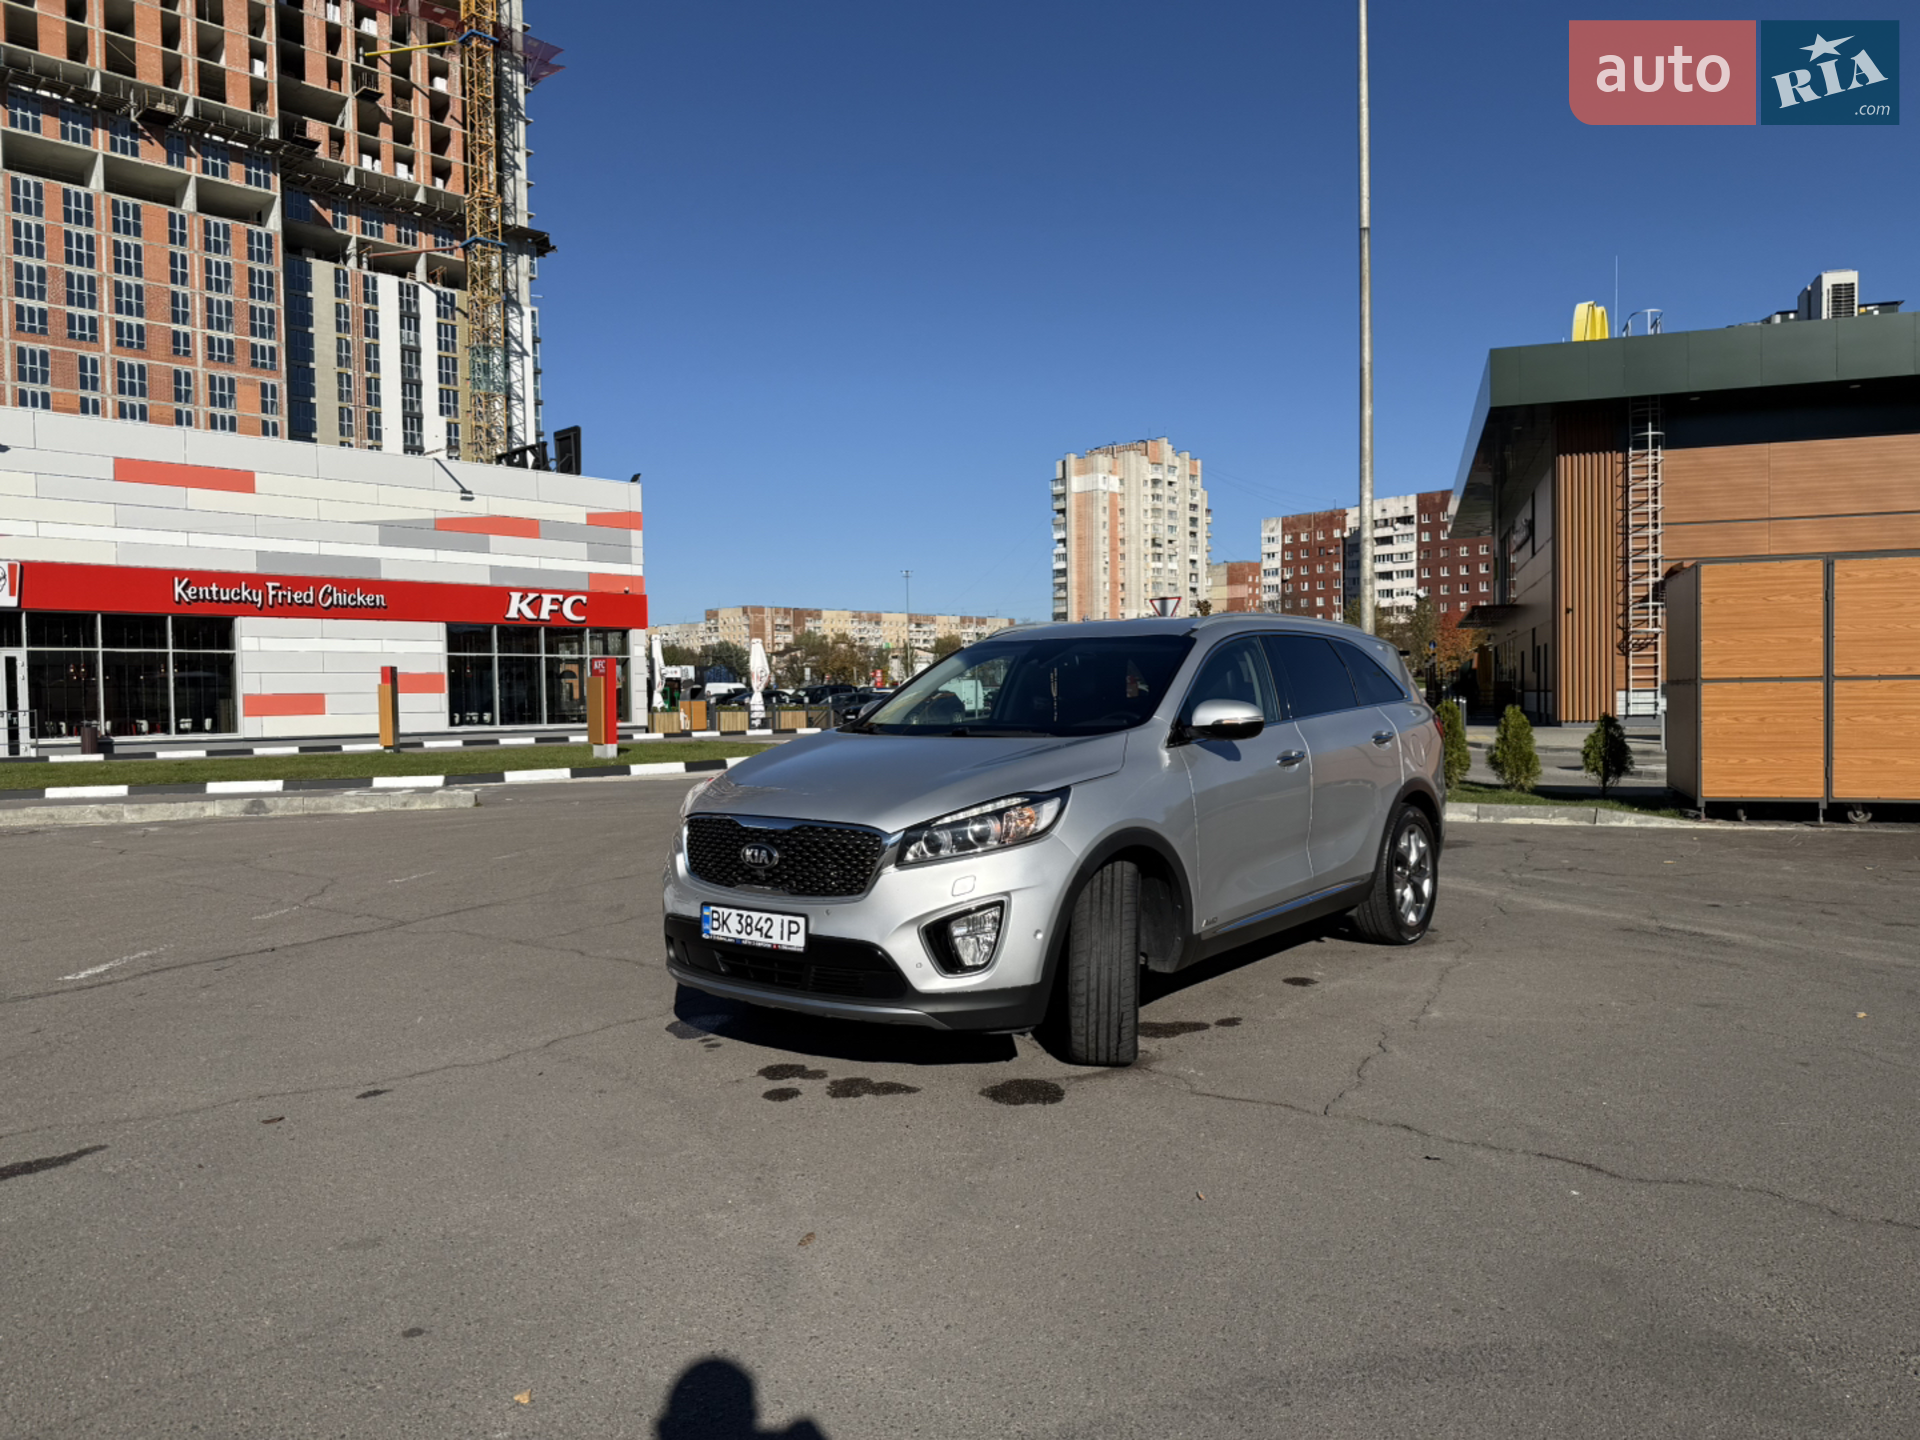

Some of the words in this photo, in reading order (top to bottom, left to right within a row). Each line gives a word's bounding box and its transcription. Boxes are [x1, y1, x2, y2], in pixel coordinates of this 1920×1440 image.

[174, 576, 263, 609] Kentucky
[265, 582, 315, 607] Fried
[317, 584, 387, 609] Chicken
[504, 591, 588, 622] KFC
[745, 848, 769, 864] KIA
[711, 910, 732, 933] BK
[735, 913, 774, 939] 3842
[780, 918, 801, 941] IP
